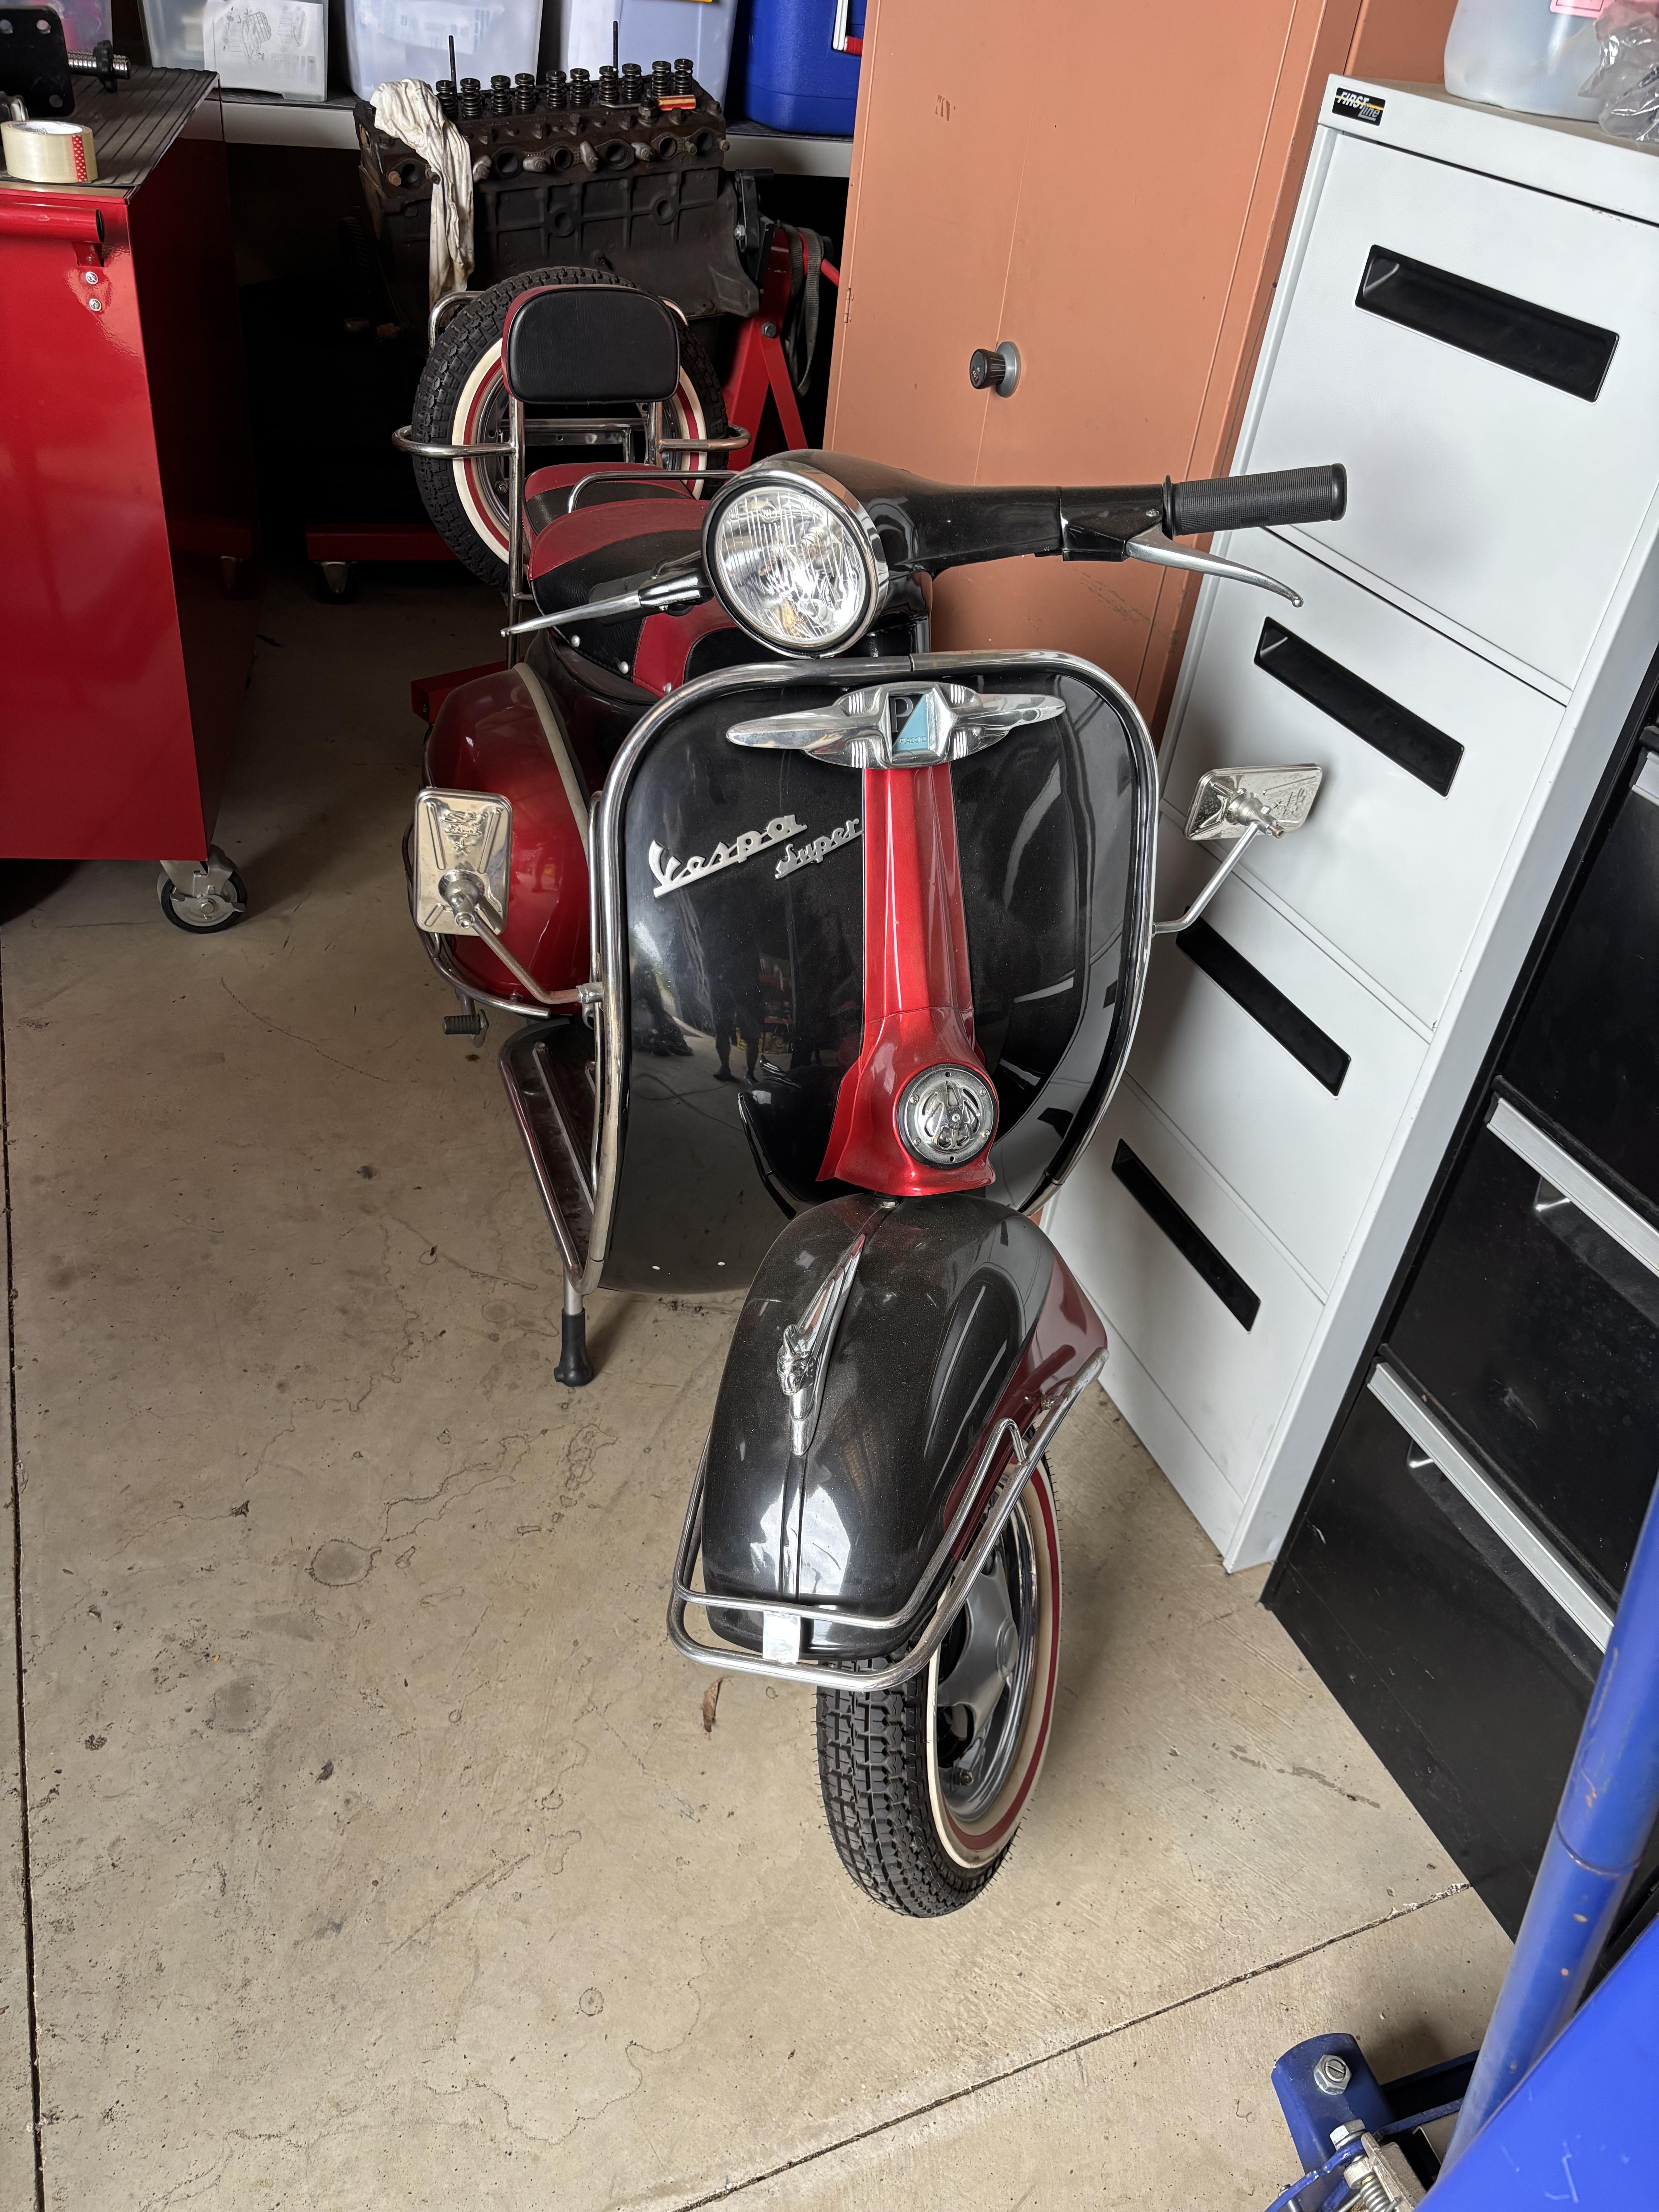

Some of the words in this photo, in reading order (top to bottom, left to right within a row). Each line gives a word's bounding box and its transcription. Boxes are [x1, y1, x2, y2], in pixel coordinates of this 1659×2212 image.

[1337, 91, 1370, 109] FIRST
[890, 696, 913, 733] P
[649, 814, 808, 898] Vespa
[775, 818, 863, 879] Super
